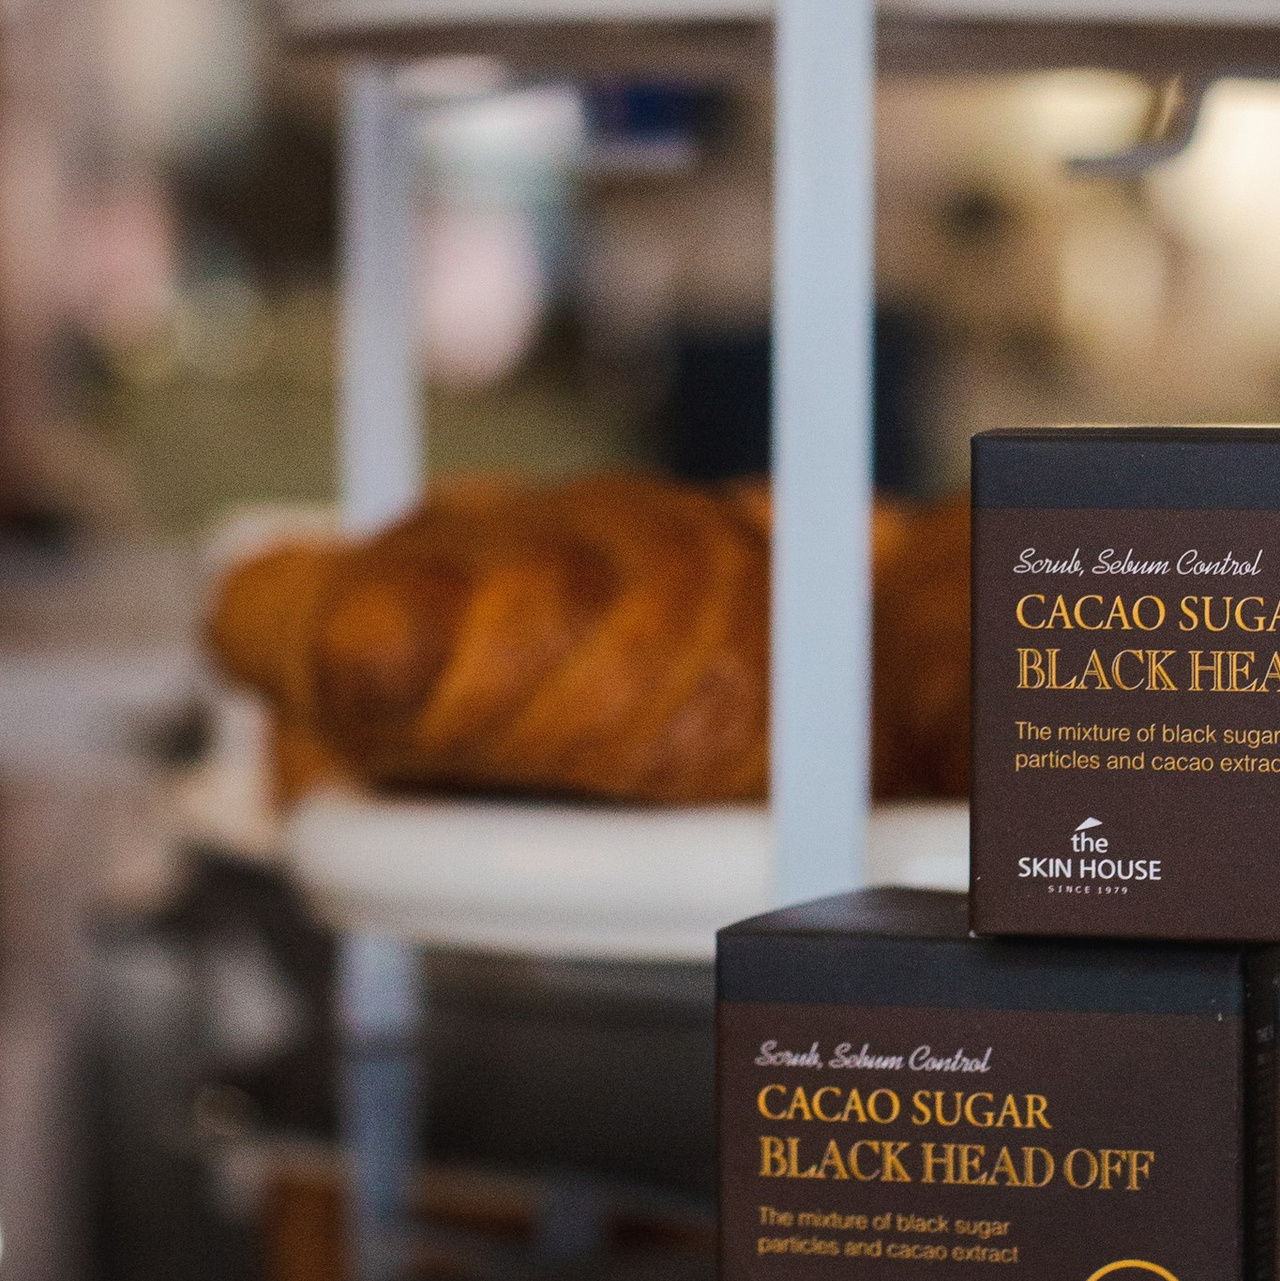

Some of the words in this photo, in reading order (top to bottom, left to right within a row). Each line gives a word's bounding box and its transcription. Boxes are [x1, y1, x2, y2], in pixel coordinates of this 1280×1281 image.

[1013, 547, 1084, 577] Scrub,
[1092, 548, 1171, 575] Sebum
[1176, 549, 1263, 575] Control
[1016, 594, 1165, 631] CACAO
[1017, 648, 1178, 691] BLACK
[1015, 721, 1052, 740] The
[1058, 723, 1130, 742] mixture
[1136, 723, 1156, 742] of
[1162, 724, 1217, 743] black
[1223, 729, 1280, 749] sugar
[1015, 750, 1100, 772] particles
[1107, 752, 1144, 770] and
[1151, 756, 1214, 772] cacao
[1070, 832, 1108, 854] the
[1018, 857, 1072, 878] SKIN
[1080, 859, 1161, 880] HOUSE
[1048, 885, 1090, 894] SINCE
[1098, 886, 1128, 894] 1979
[757, 1085, 900, 1123] CACAO
[912, 1090, 1051, 1129] SUGAR
[760, 1136, 911, 1182] BLACK
[922, 1143, 1055, 1187] HEAD
[1064, 1148, 1155, 1190] OFF
